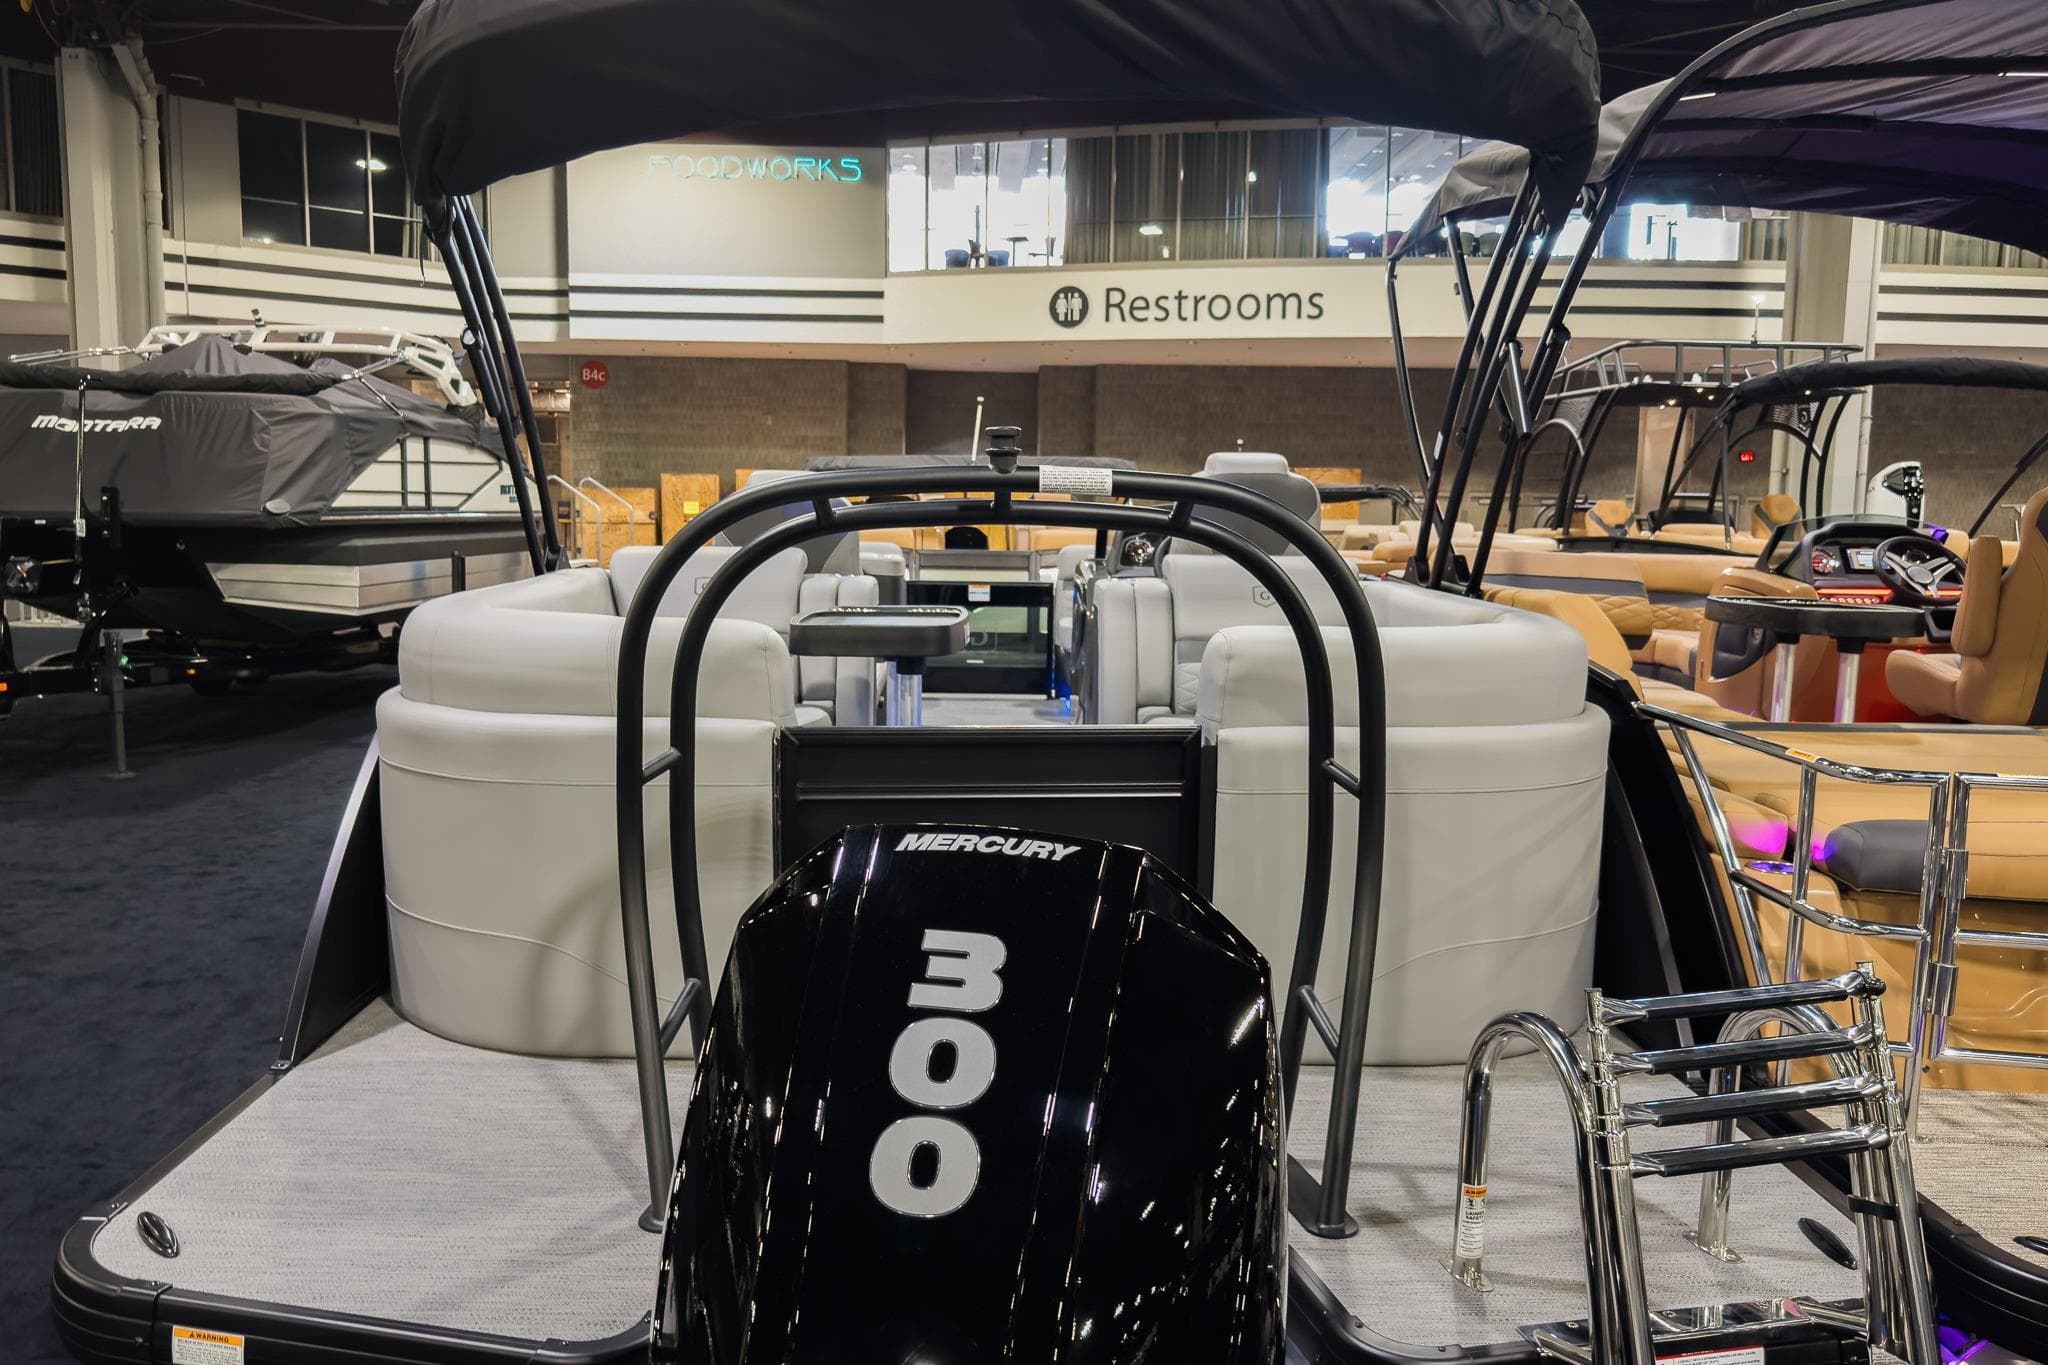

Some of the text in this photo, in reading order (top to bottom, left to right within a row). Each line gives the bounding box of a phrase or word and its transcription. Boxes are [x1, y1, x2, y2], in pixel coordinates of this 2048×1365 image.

[648, 155, 864, 183] FOODWORKS
[1104, 287, 1325, 323] Restrooms
[582, 368, 606, 382] B4c
[31, 414, 162, 433] MONTARA
[894, 833, 1081, 862] MERCURY
[869, 928, 1007, 1218] 300
[193, 1331, 229, 1343] WARNING
